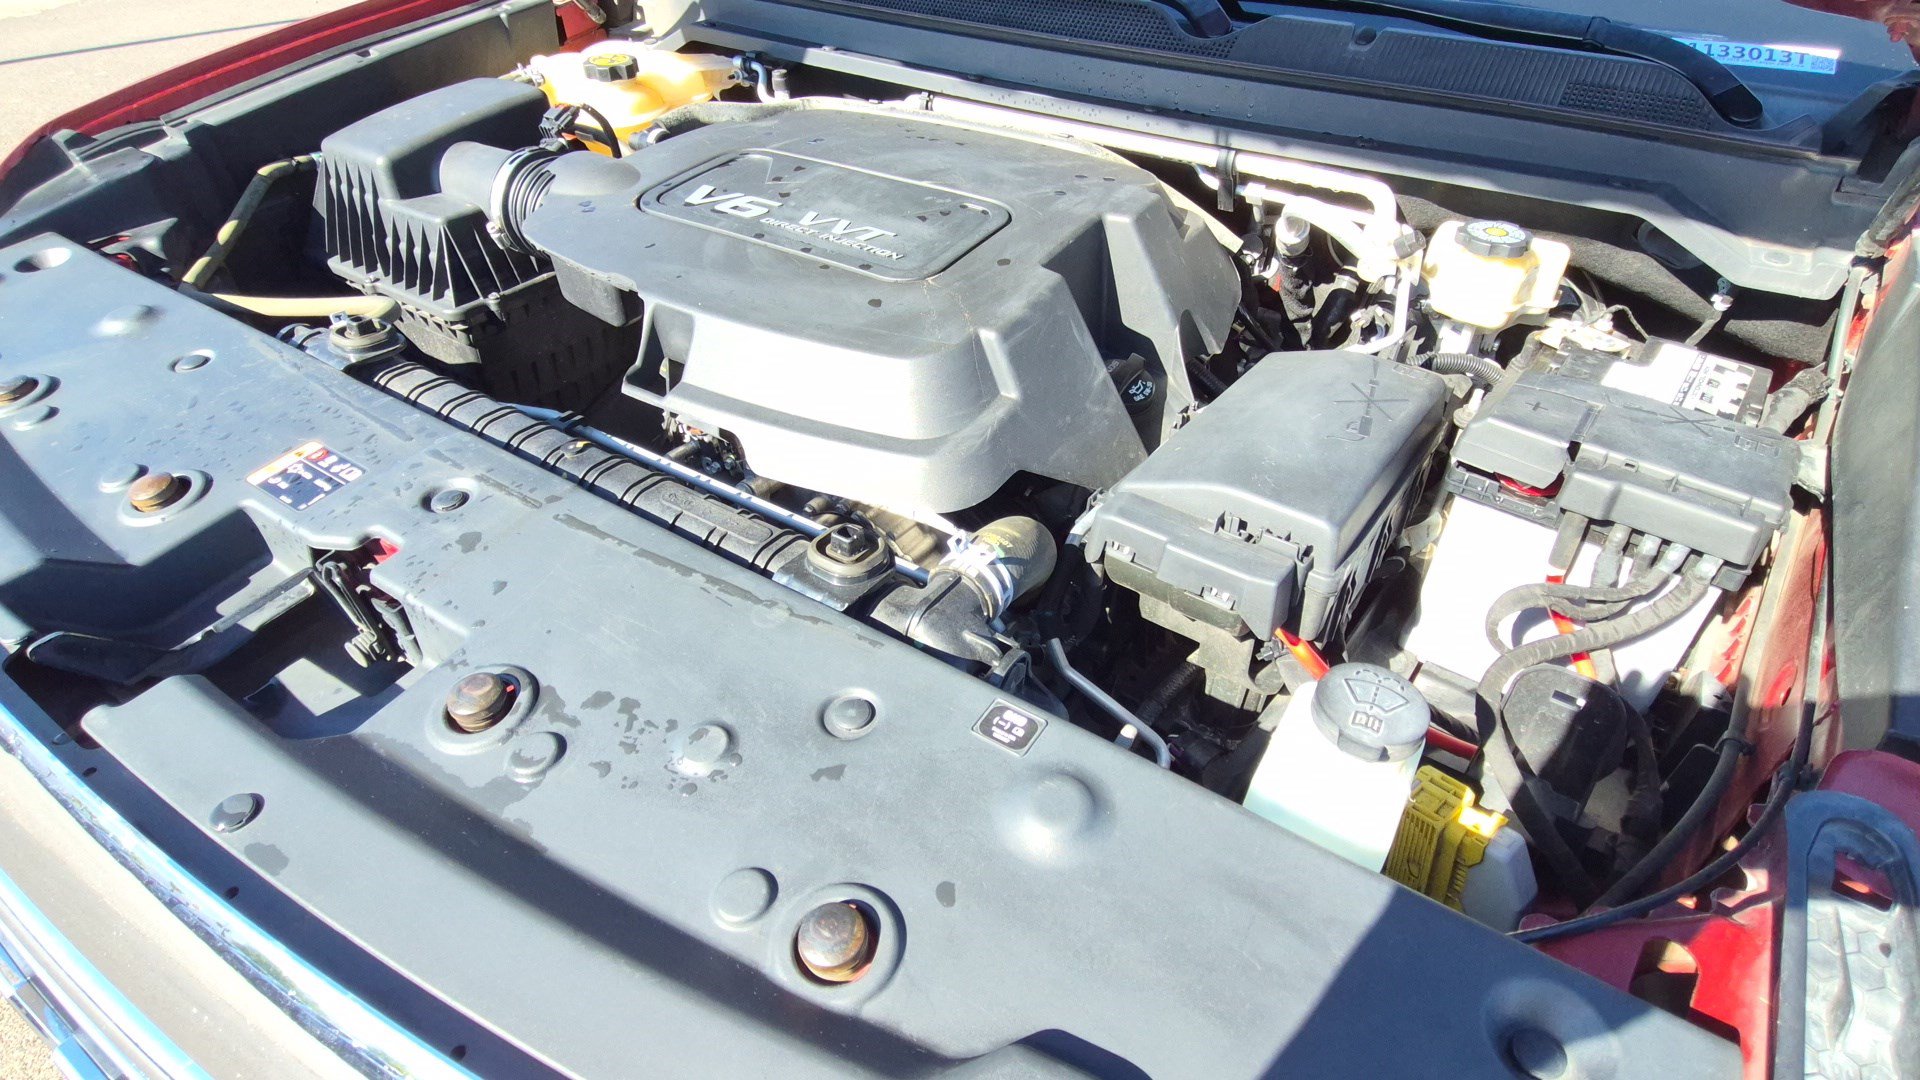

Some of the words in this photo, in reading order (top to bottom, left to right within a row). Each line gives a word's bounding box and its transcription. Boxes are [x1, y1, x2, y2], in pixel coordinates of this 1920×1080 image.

[685, 184, 783, 218] V6
[798, 211, 897, 241] VVT
[760, 218, 820, 235] DIRECT
[818, 233, 904, 260] INJECTION
